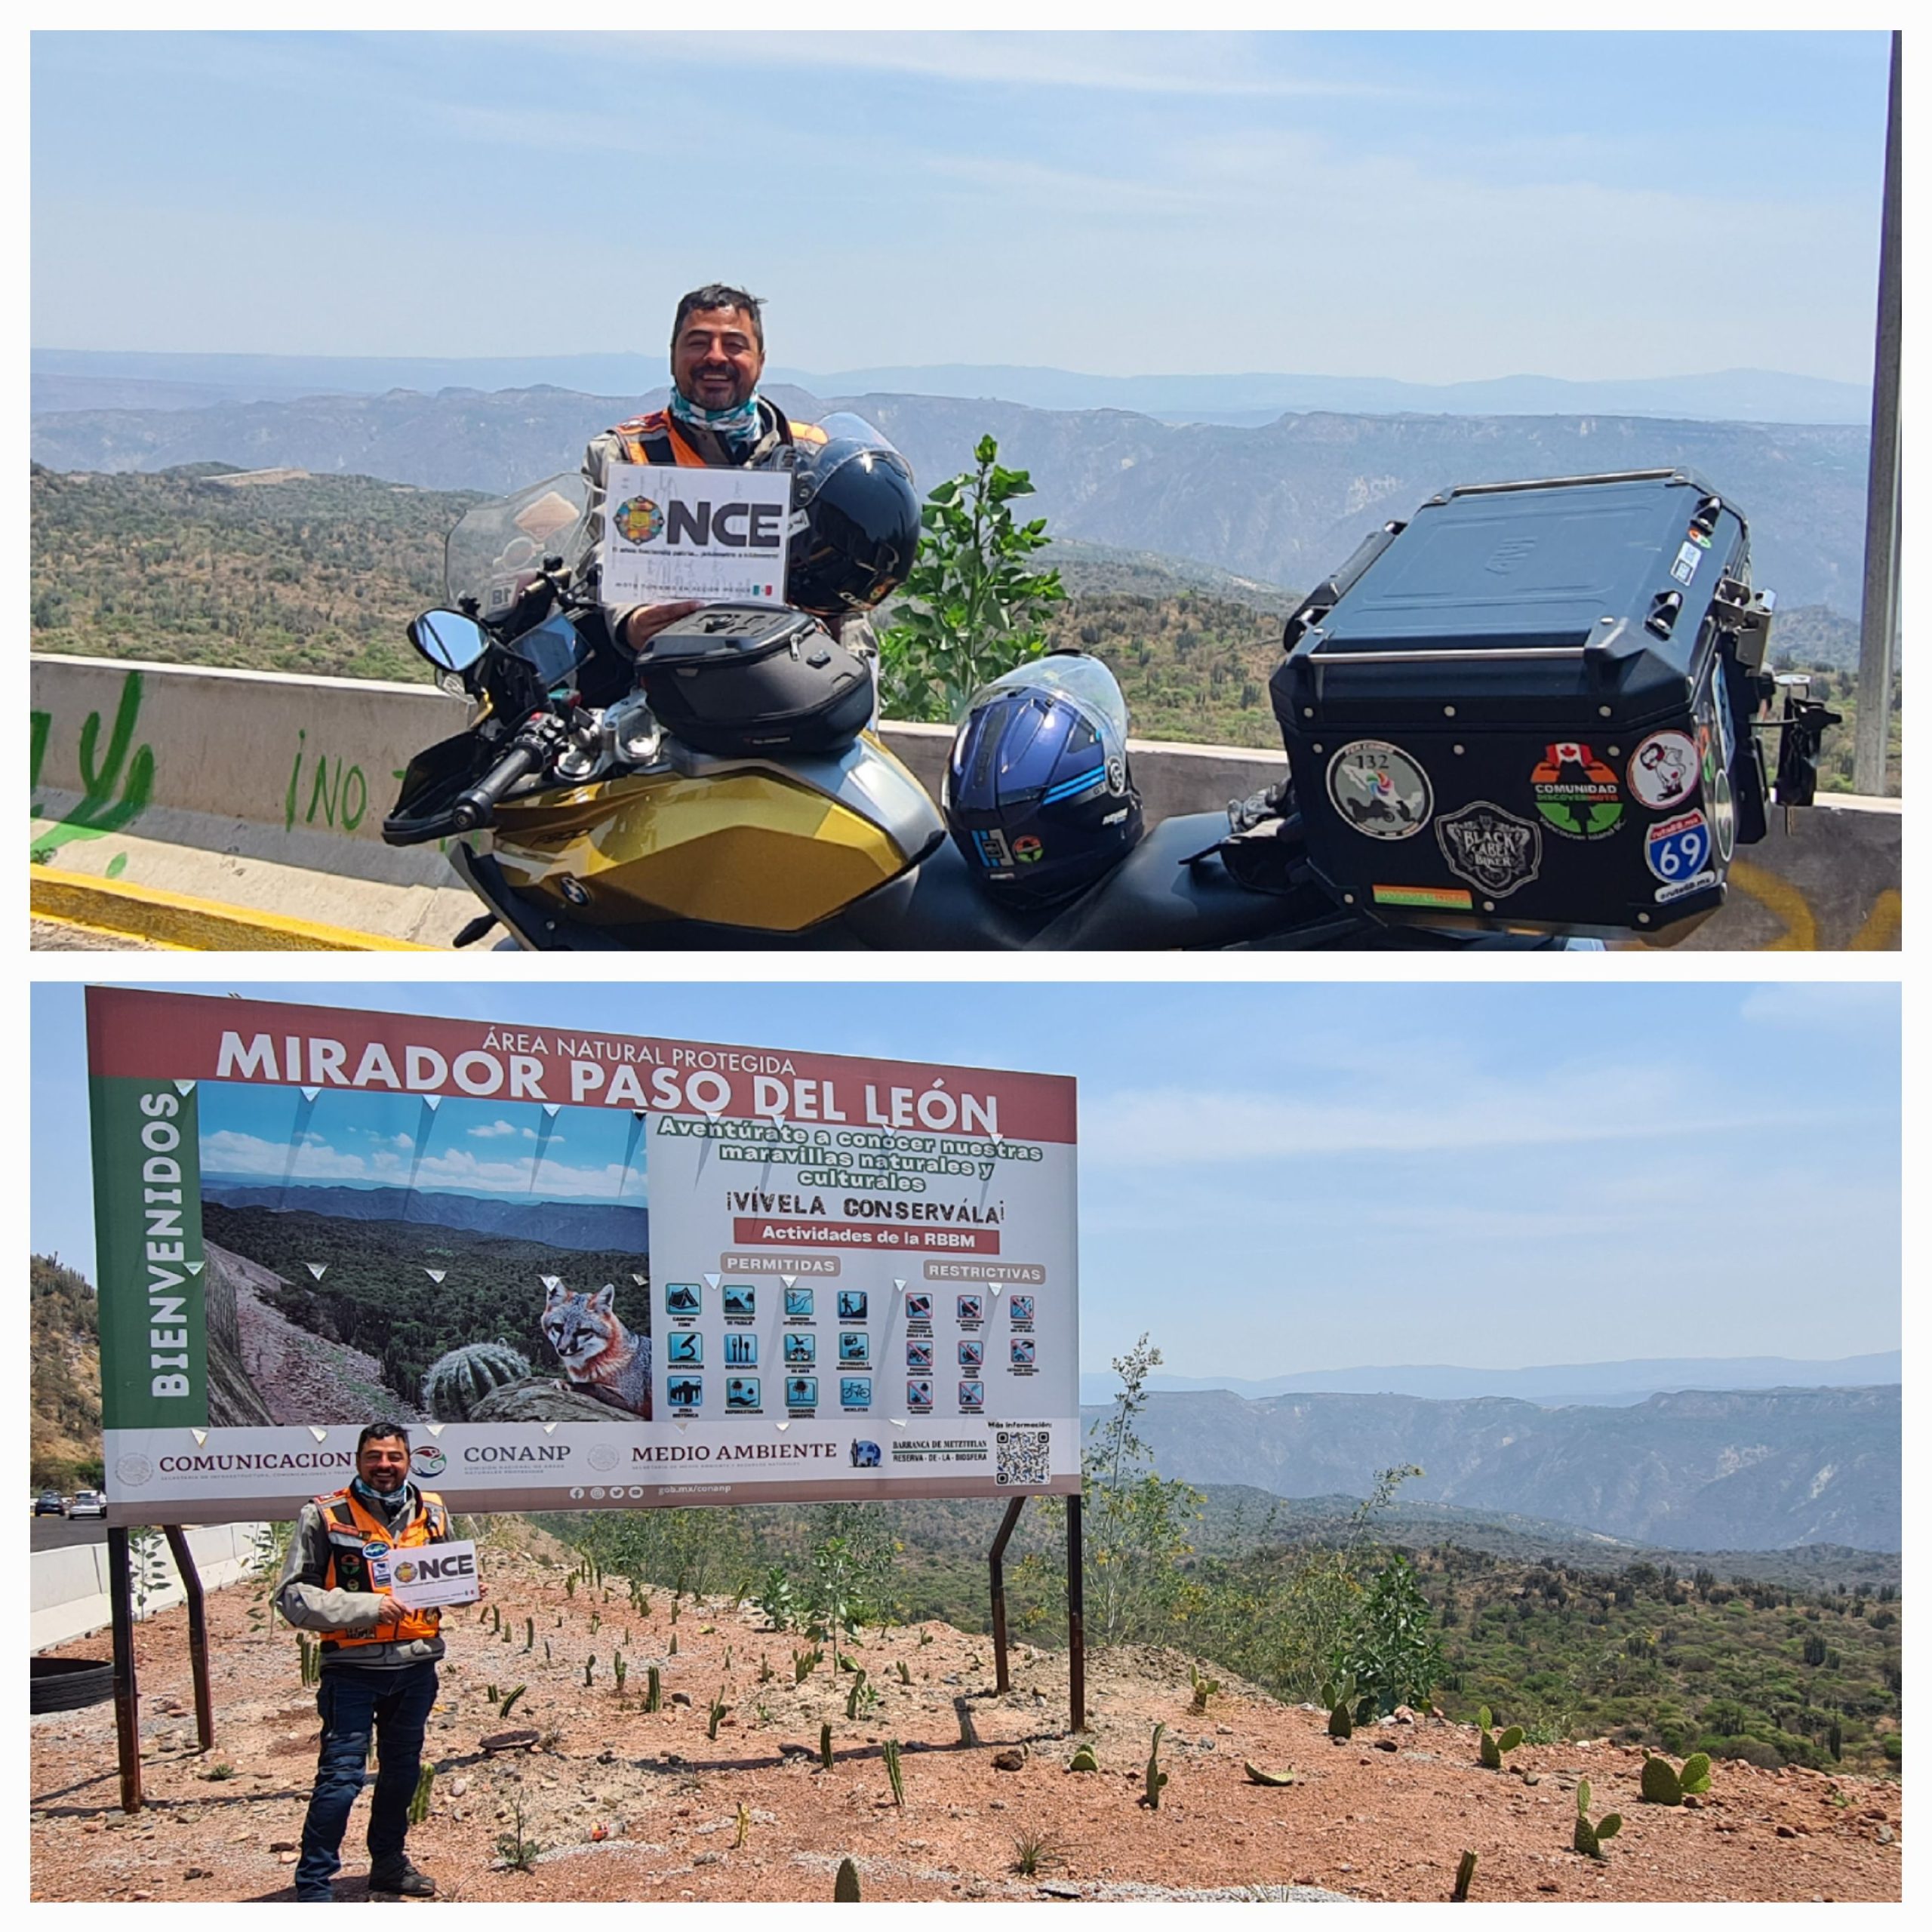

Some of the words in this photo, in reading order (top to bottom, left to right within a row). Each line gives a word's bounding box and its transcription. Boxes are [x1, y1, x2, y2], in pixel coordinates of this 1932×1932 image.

[1355, 754, 1389, 769] 132
[1535, 784, 1617, 794] COMUNIDAD
[1463, 831, 1517, 856] BLACK
[1660, 832, 1701, 876] 69
[481, 1026, 549, 1055] ÁREA
[557, 1038, 665, 1066] NATURAL
[672, 1048, 797, 1076] PROTEGIDA
[216, 1030, 548, 1100] MIRADOR
[570, 1060, 732, 1114] PASO
[753, 1074, 847, 1122] DEL
[865, 1077, 1000, 1134] LEÓN
[657, 1116, 809, 1145] Aventúrate
[815, 1131, 830, 1146] a
[838, 1134, 935, 1153] conocer
[941, 1138, 1044, 1162] nuestras
[719, 1144, 853, 1168] maravillas
[859, 1153, 973, 1176] naturales
[978, 1162, 995, 1180] y
[798, 1168, 926, 1192] culturales
[727, 1186, 826, 1216] ¡VÍVELA
[140, 1093, 189, 1398] BIENVENIDOS
[762, 1225, 874, 1245] Actividades
[876, 1231, 900, 1245] de
[904, 1232, 920, 1247] la
[924, 1232, 976, 1248] RBBM
[727, 1257, 835, 1273] PERMITIDAS
[928, 1264, 1041, 1281] RESTRICTIVAS
[1005, 1421, 1053, 1429] información:
[463, 1445, 571, 1463] CONANP
[632, 1446, 711, 1462] MEDIO
[716, 1443, 837, 1460] AMBIENTE
[892, 1441, 931, 1450] BARRANCA
[932, 1441, 943, 1449] DE
[159, 1451, 358, 1473] COMUNICACION
[929, 1454, 938, 1462] DE
[658, 1484, 732, 1496] gob.mx/conanp
